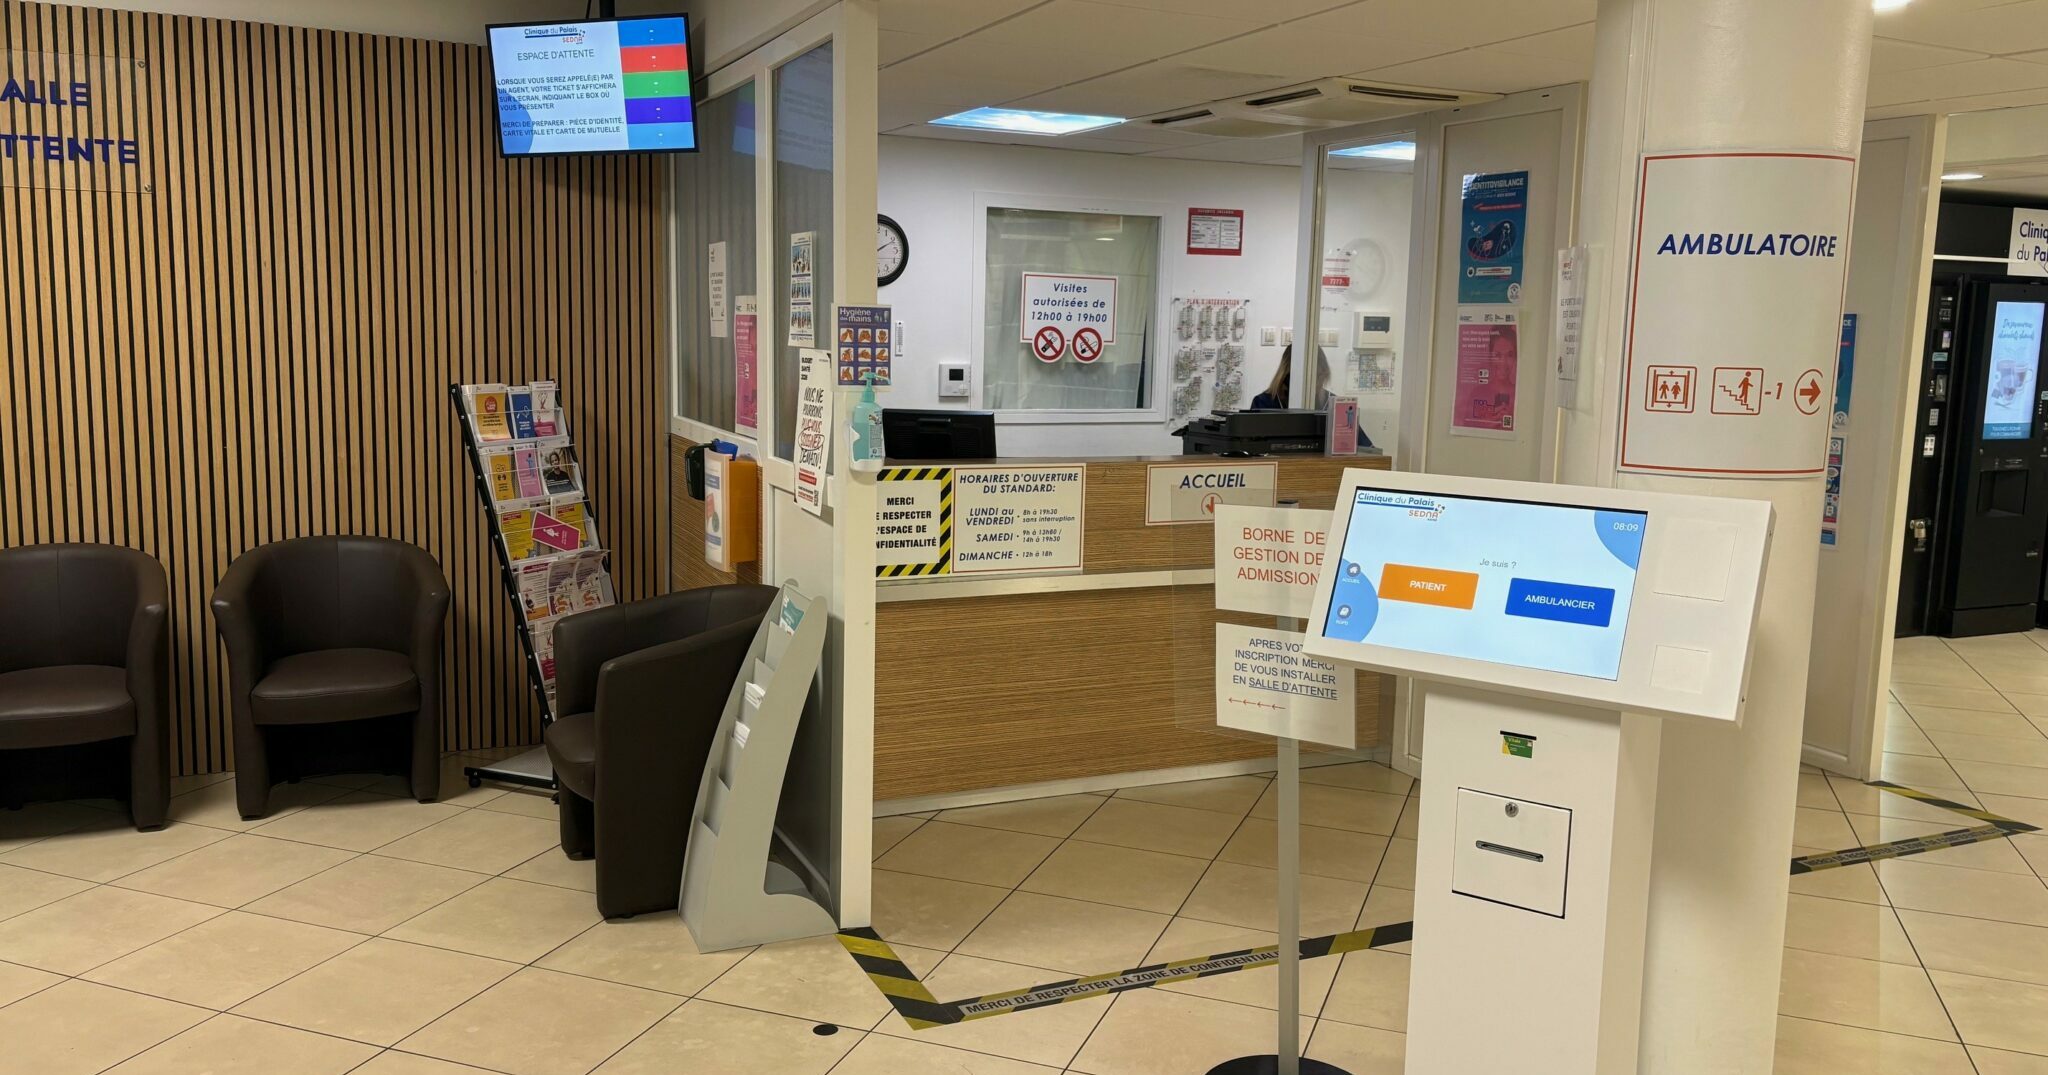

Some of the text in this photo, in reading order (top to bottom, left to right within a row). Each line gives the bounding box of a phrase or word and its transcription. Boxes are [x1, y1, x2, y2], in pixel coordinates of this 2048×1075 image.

[524, 28, 548, 36] Clinique
[518, 49, 594, 61] ESPACE D'ATTENTE
[1657, 234, 1837, 257] AMBULATOIRE
[2017, 243, 2029, 261] du
[1054, 283, 1088, 293] Visites
[1033, 297, 1106, 308] autorisées de
[840, 308, 871, 316] Hygiène
[1032, 311, 1107, 322] 12h00 à 19h00
[960, 473, 1078, 483] HORAIRES D'OUVERTURE
[1179, 473, 1246, 489] ACCUEIL
[983, 484, 1056, 494] DU STANDARD:
[887, 497, 914, 505] MERCI
[1358, 493, 1393, 504] Clinique
[1408, 498, 1435, 507] Palais
[883, 511, 932, 520] RESPECTER
[970, 508, 999, 516] LUNDI
[966, 517, 1014, 526] VENDREDI
[1613, 522, 1638, 531] 08:09
[876, 525, 927, 534] 'ESPACE DE
[976, 533, 1013, 542] SAMEDI
[1243, 527, 1325, 545] BORNE DE
[960, 551, 1013, 561] DIMANCHE
[1234, 547, 1299, 564] GESTION
[1492, 560, 1509, 568] suis
[1410, 580, 1447, 592] PATIENT
[1524, 594, 1595, 610] AMBULANCIER
[1249, 638, 1282, 650] APRES
[1235, 649, 1298, 666] INSCRIPTION
[1235, 662, 1336, 685] DE VOUS INSTALLER
[1233, 675, 1338, 699] EN SALLE D'ATTENTE
[966, 995, 1011, 1013] MERCI
[1016, 994, 1033, 1004] DE
[1037, 980, 1114, 1000] RESPECTER
[1116, 977, 1131, 986] LA
[1133, 971, 1170, 982] ZONE
[1171, 966, 1189, 975] DE
